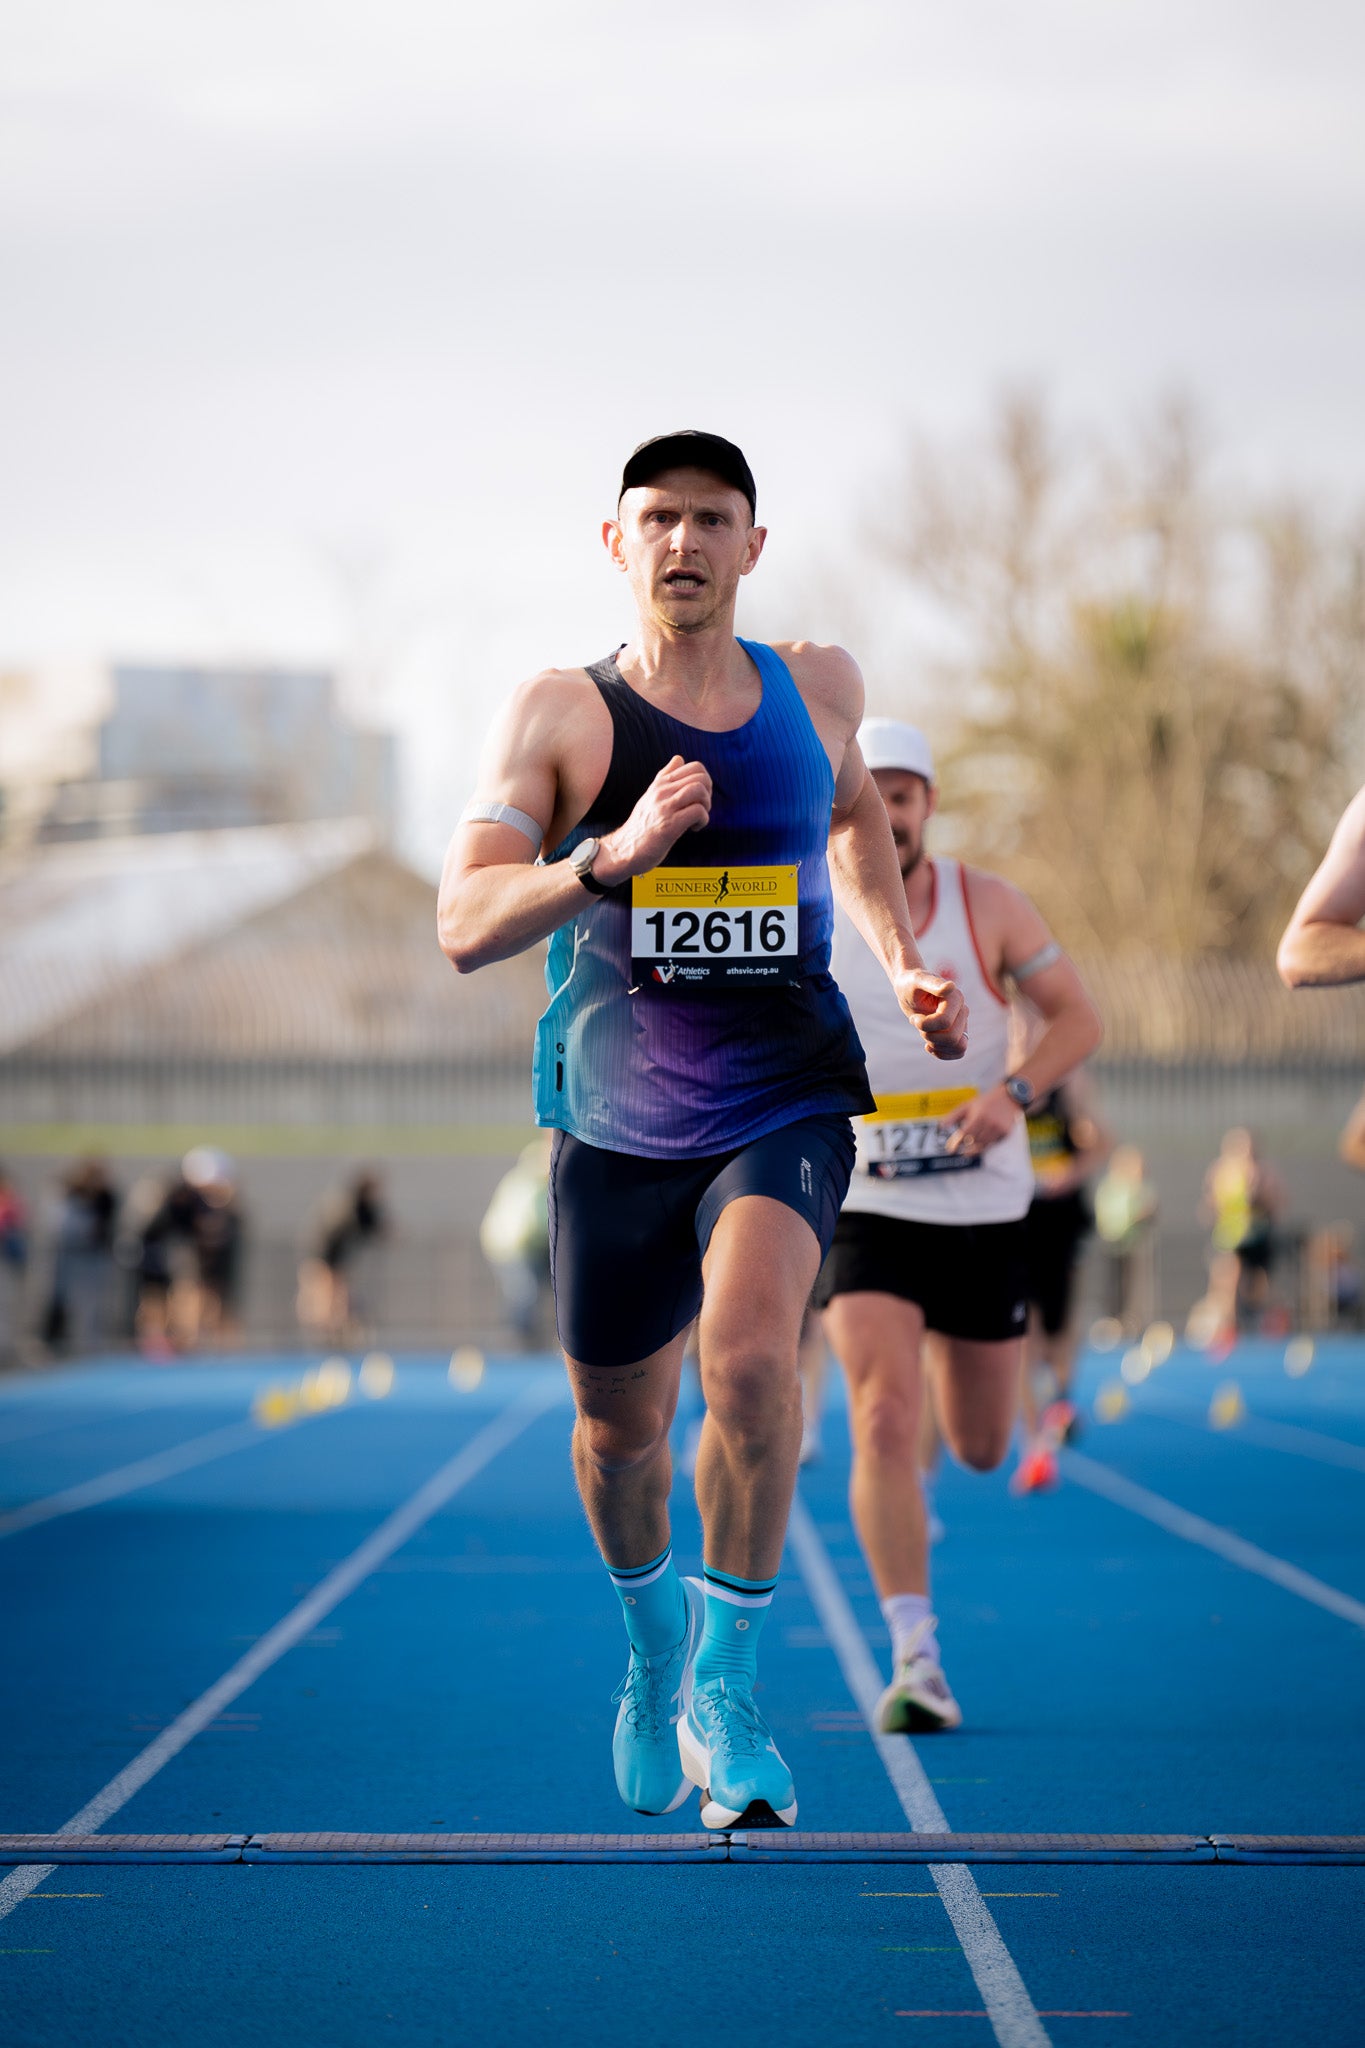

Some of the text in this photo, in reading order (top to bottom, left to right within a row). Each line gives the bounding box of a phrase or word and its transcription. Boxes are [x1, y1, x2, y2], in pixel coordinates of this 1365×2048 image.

[655, 881, 778, 893] RUNNERS WORLD
[645, 910, 786, 954] 12616
[677, 966, 779, 976] Athletics athsvic.org.au
